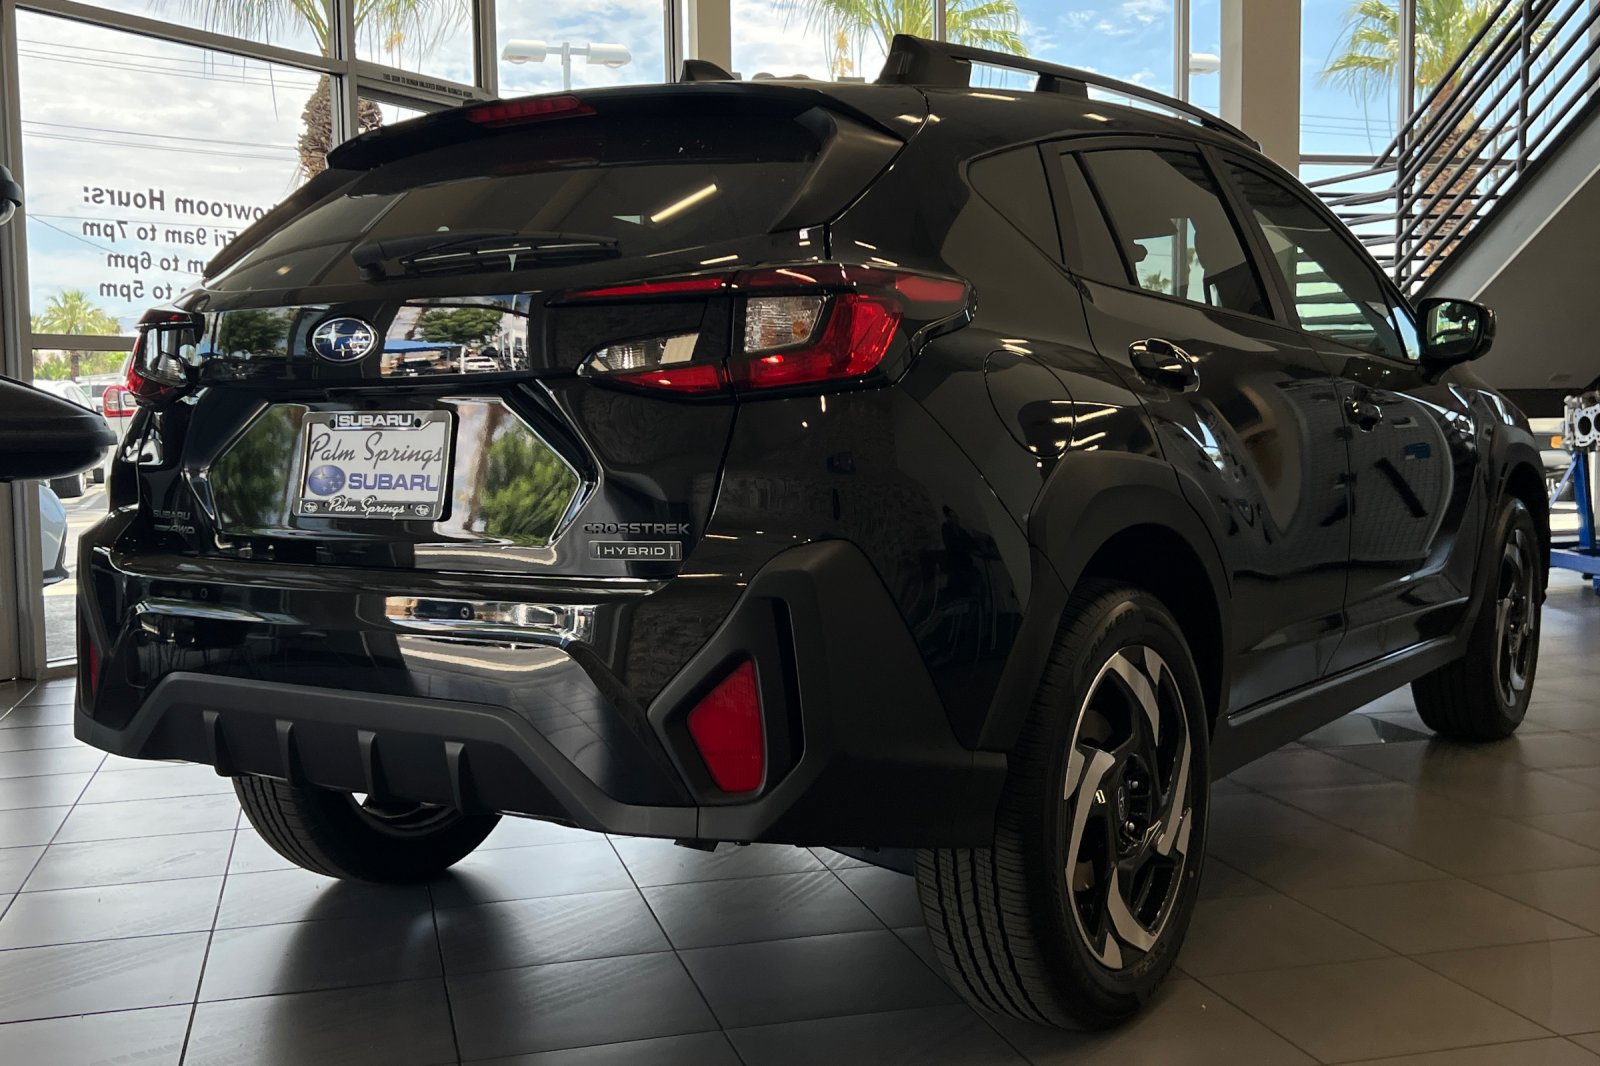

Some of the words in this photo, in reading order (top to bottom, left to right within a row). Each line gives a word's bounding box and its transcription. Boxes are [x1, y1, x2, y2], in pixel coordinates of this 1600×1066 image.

[338, 414, 412, 427] SUBARU
[310, 432, 355, 462] Palm
[364, 431, 443, 471] Springs
[348, 473, 440, 492] SUBARU
[327, 495, 357, 513] Palm
[360, 495, 406, 520] Springs
[582, 522, 690, 535] CROSSTREK
[604, 546, 666, 556] HYBRID
